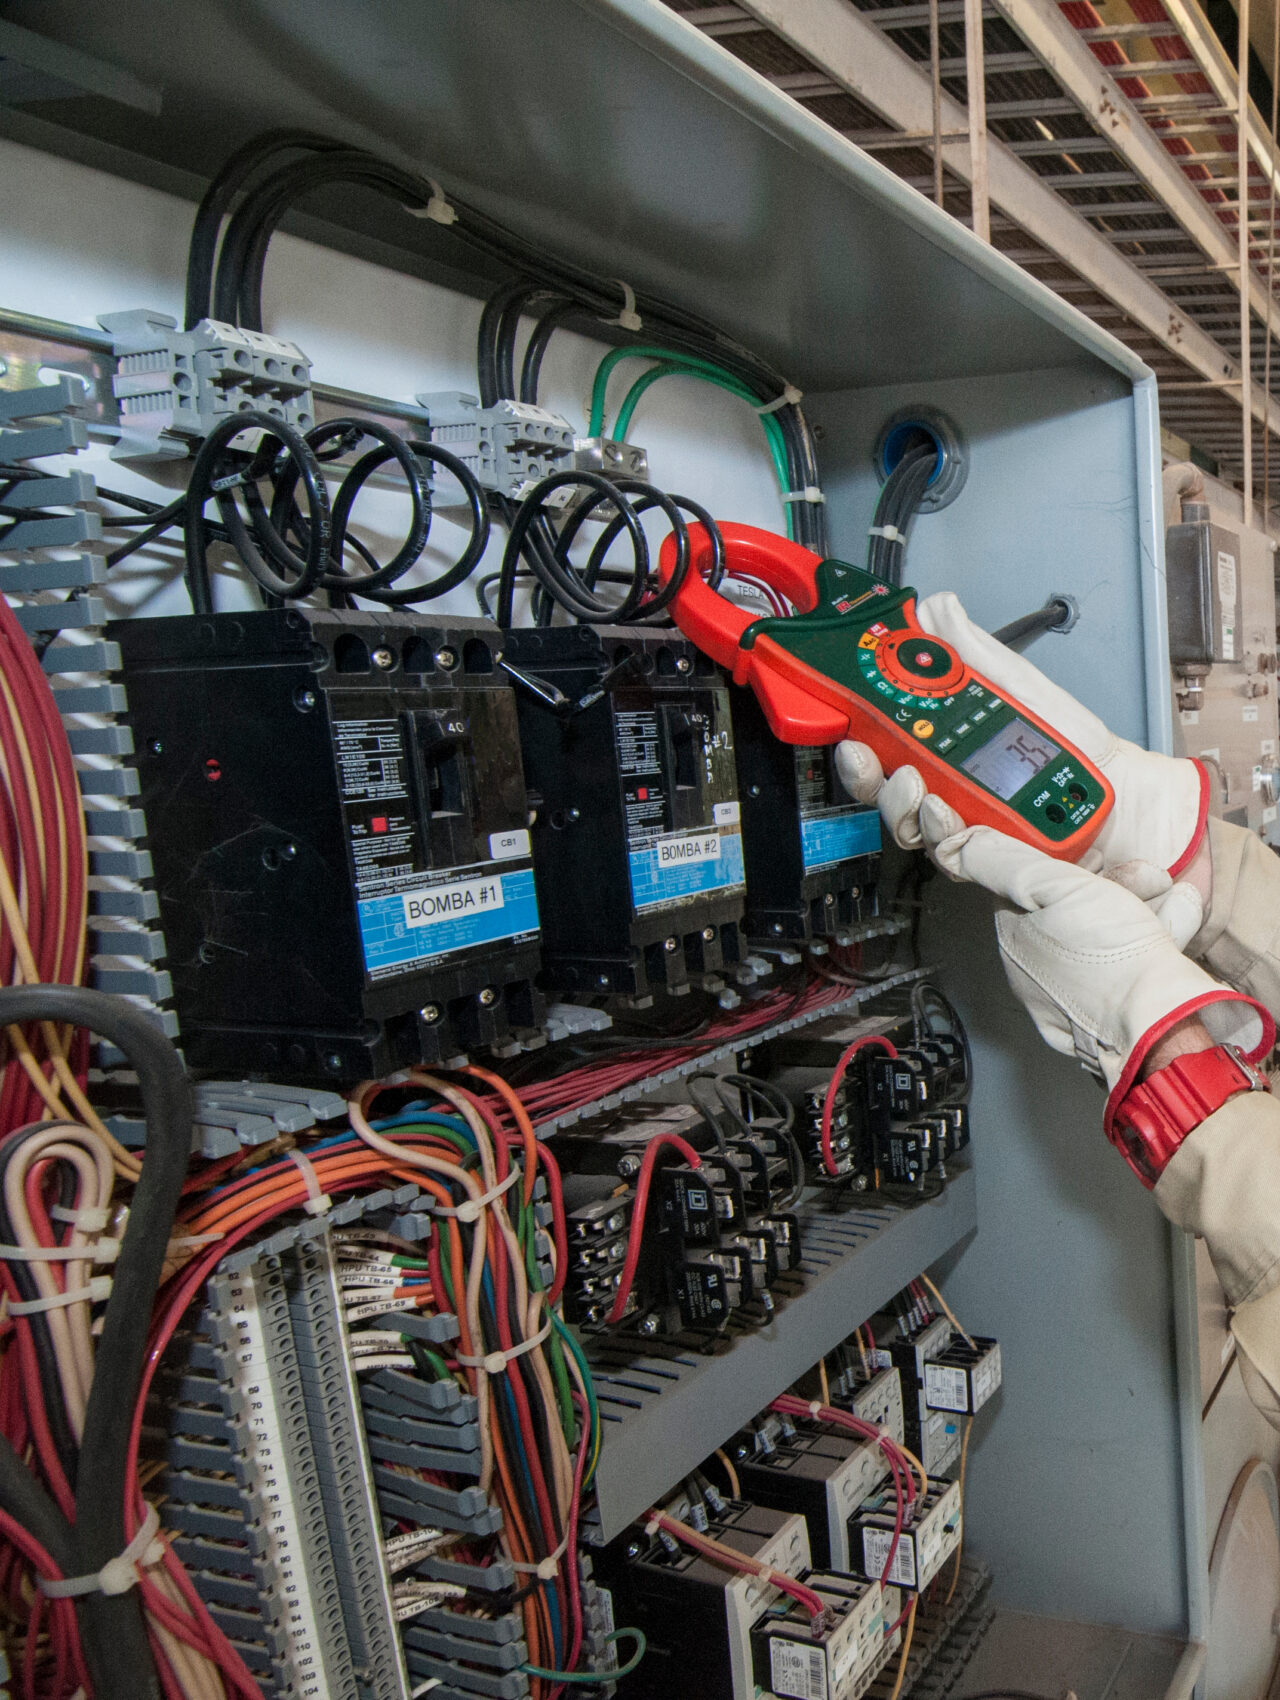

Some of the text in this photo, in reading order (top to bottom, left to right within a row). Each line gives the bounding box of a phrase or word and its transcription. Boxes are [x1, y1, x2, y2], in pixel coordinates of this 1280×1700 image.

[448, 721, 465, 733] 40
[918, 721, 930, 732] HOLD
[1033, 790, 1051, 808] COM
[500, 838, 517, 848] CB1
[661, 841, 702, 861] BOMBA
[704, 839, 718, 854] #2
[408, 891, 475, 920] BOMBA
[479, 885, 497, 905] #1
[341, 1264, 361, 1272] HPU
[357, 1305, 378, 1315] HPU
[251, 1401, 263, 1410] 70
[254, 1417, 264, 1426] 71
[256, 1433, 268, 1442] 72
[260, 1448, 271, 1457] 73
[262, 1464, 273, 1472] 74
[265, 1478, 276, 1487] 75
[268, 1494, 280, 1503] 76
[271, 1510, 282, 1519] 77
[274, 1525, 286, 1534] 78
[277, 1539, 289, 1549] 79
[386, 1538, 405, 1546] HPU
[292, 1627, 307, 1637] 101
[296, 1642, 311, 1652] 110
[298, 1657, 313, 1666] 102
[301, 1671, 316, 1681] 103
[303, 1686, 319, 1696] 104
